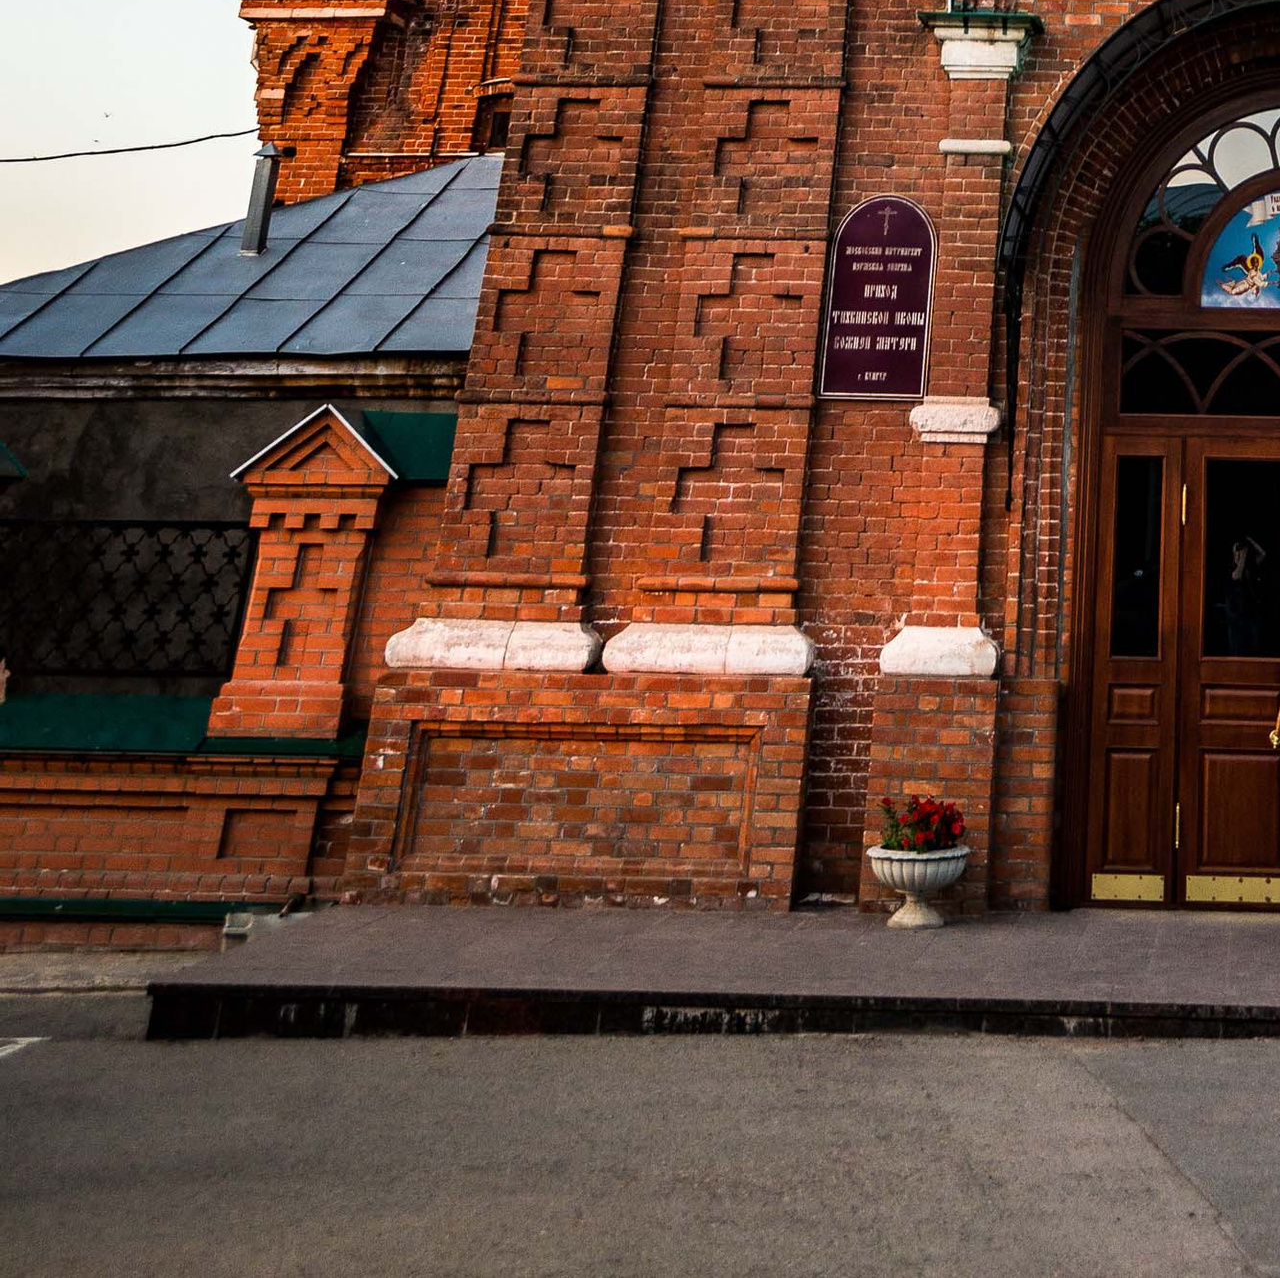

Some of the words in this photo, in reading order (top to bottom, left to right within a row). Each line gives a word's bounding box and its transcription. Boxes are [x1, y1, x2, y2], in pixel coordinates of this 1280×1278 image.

[863, 284, 898, 300] ПРИХОД
[894, 311, 925, 326] ИКОНЫ
[875, 336, 917, 351] МАТЕРИ
